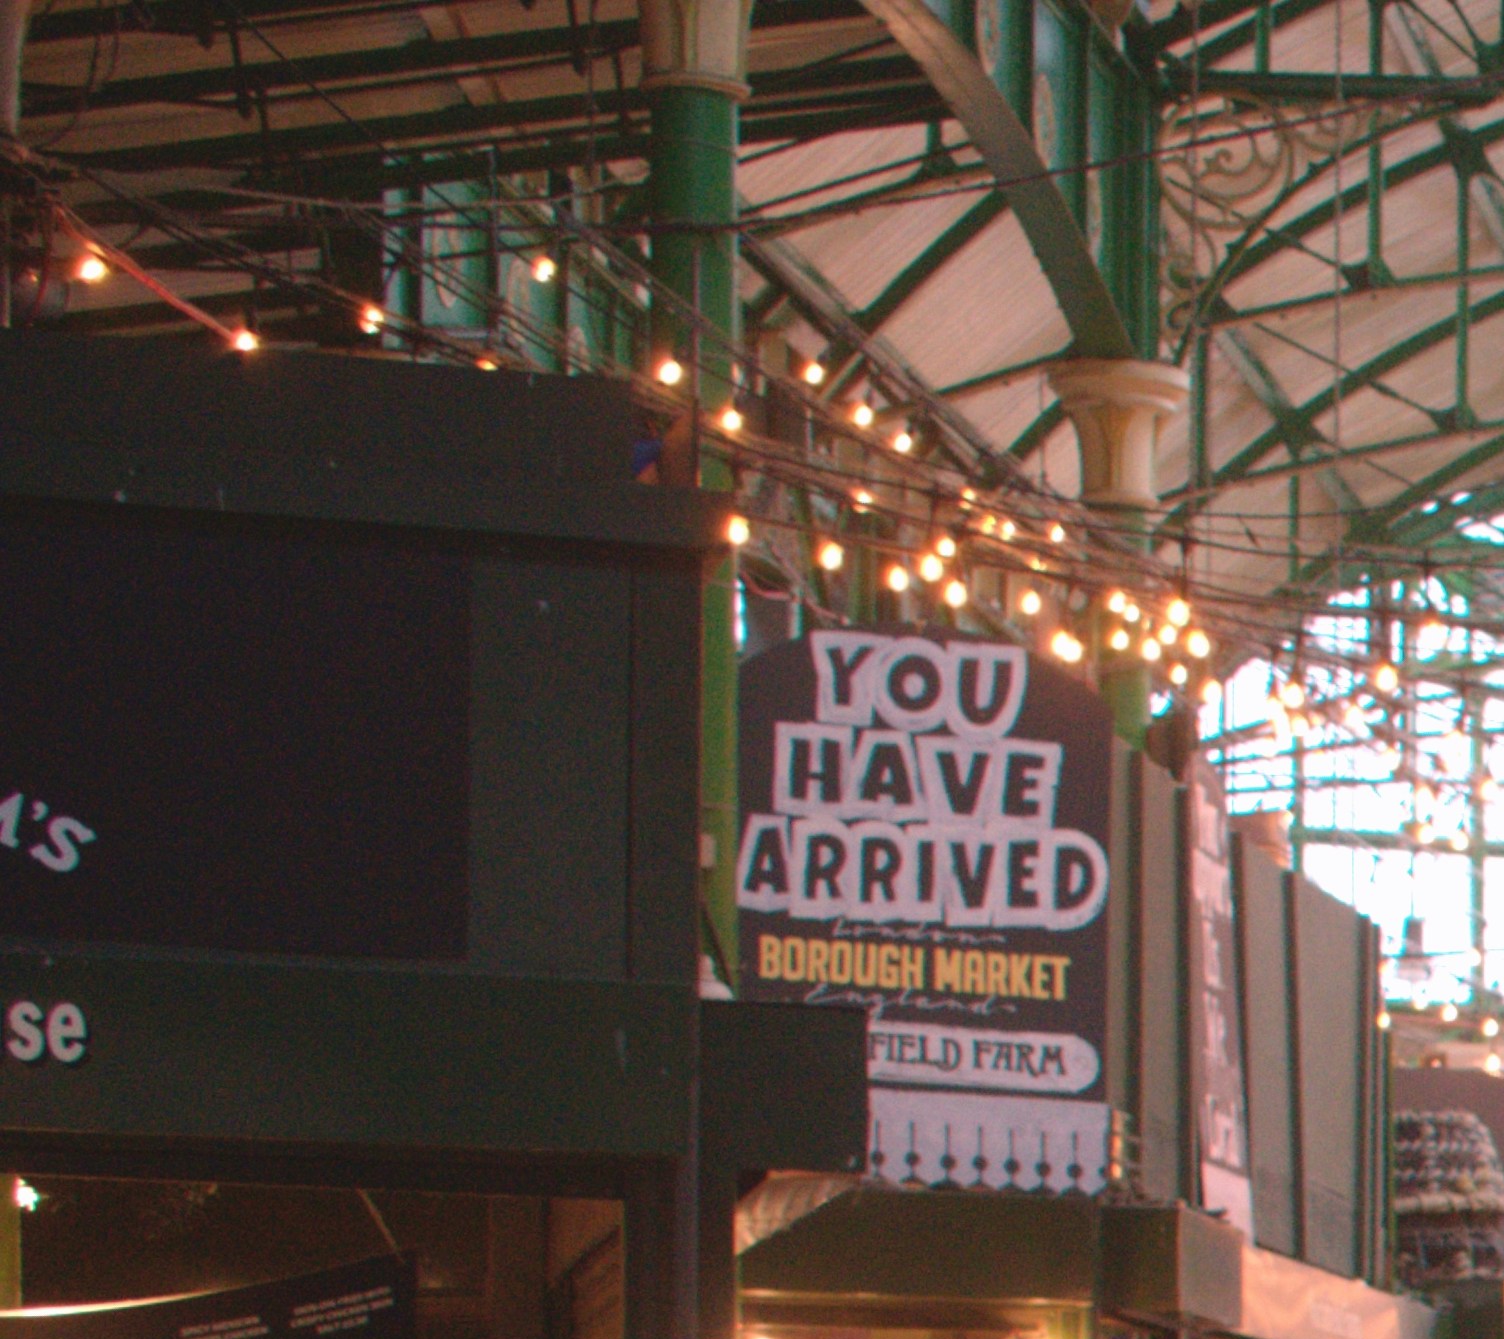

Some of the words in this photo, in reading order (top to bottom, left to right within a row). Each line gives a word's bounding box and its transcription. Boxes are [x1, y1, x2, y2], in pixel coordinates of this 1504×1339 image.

[817, 638, 1021, 733] YOU
[783, 728, 1055, 824] HAVE
[741, 820, 1103, 920] ARRIVED
[757, 933, 925, 991] BOROUGH
[932, 946, 1072, 1001] MARKET
[971, 1037, 1068, 1079] FARM
